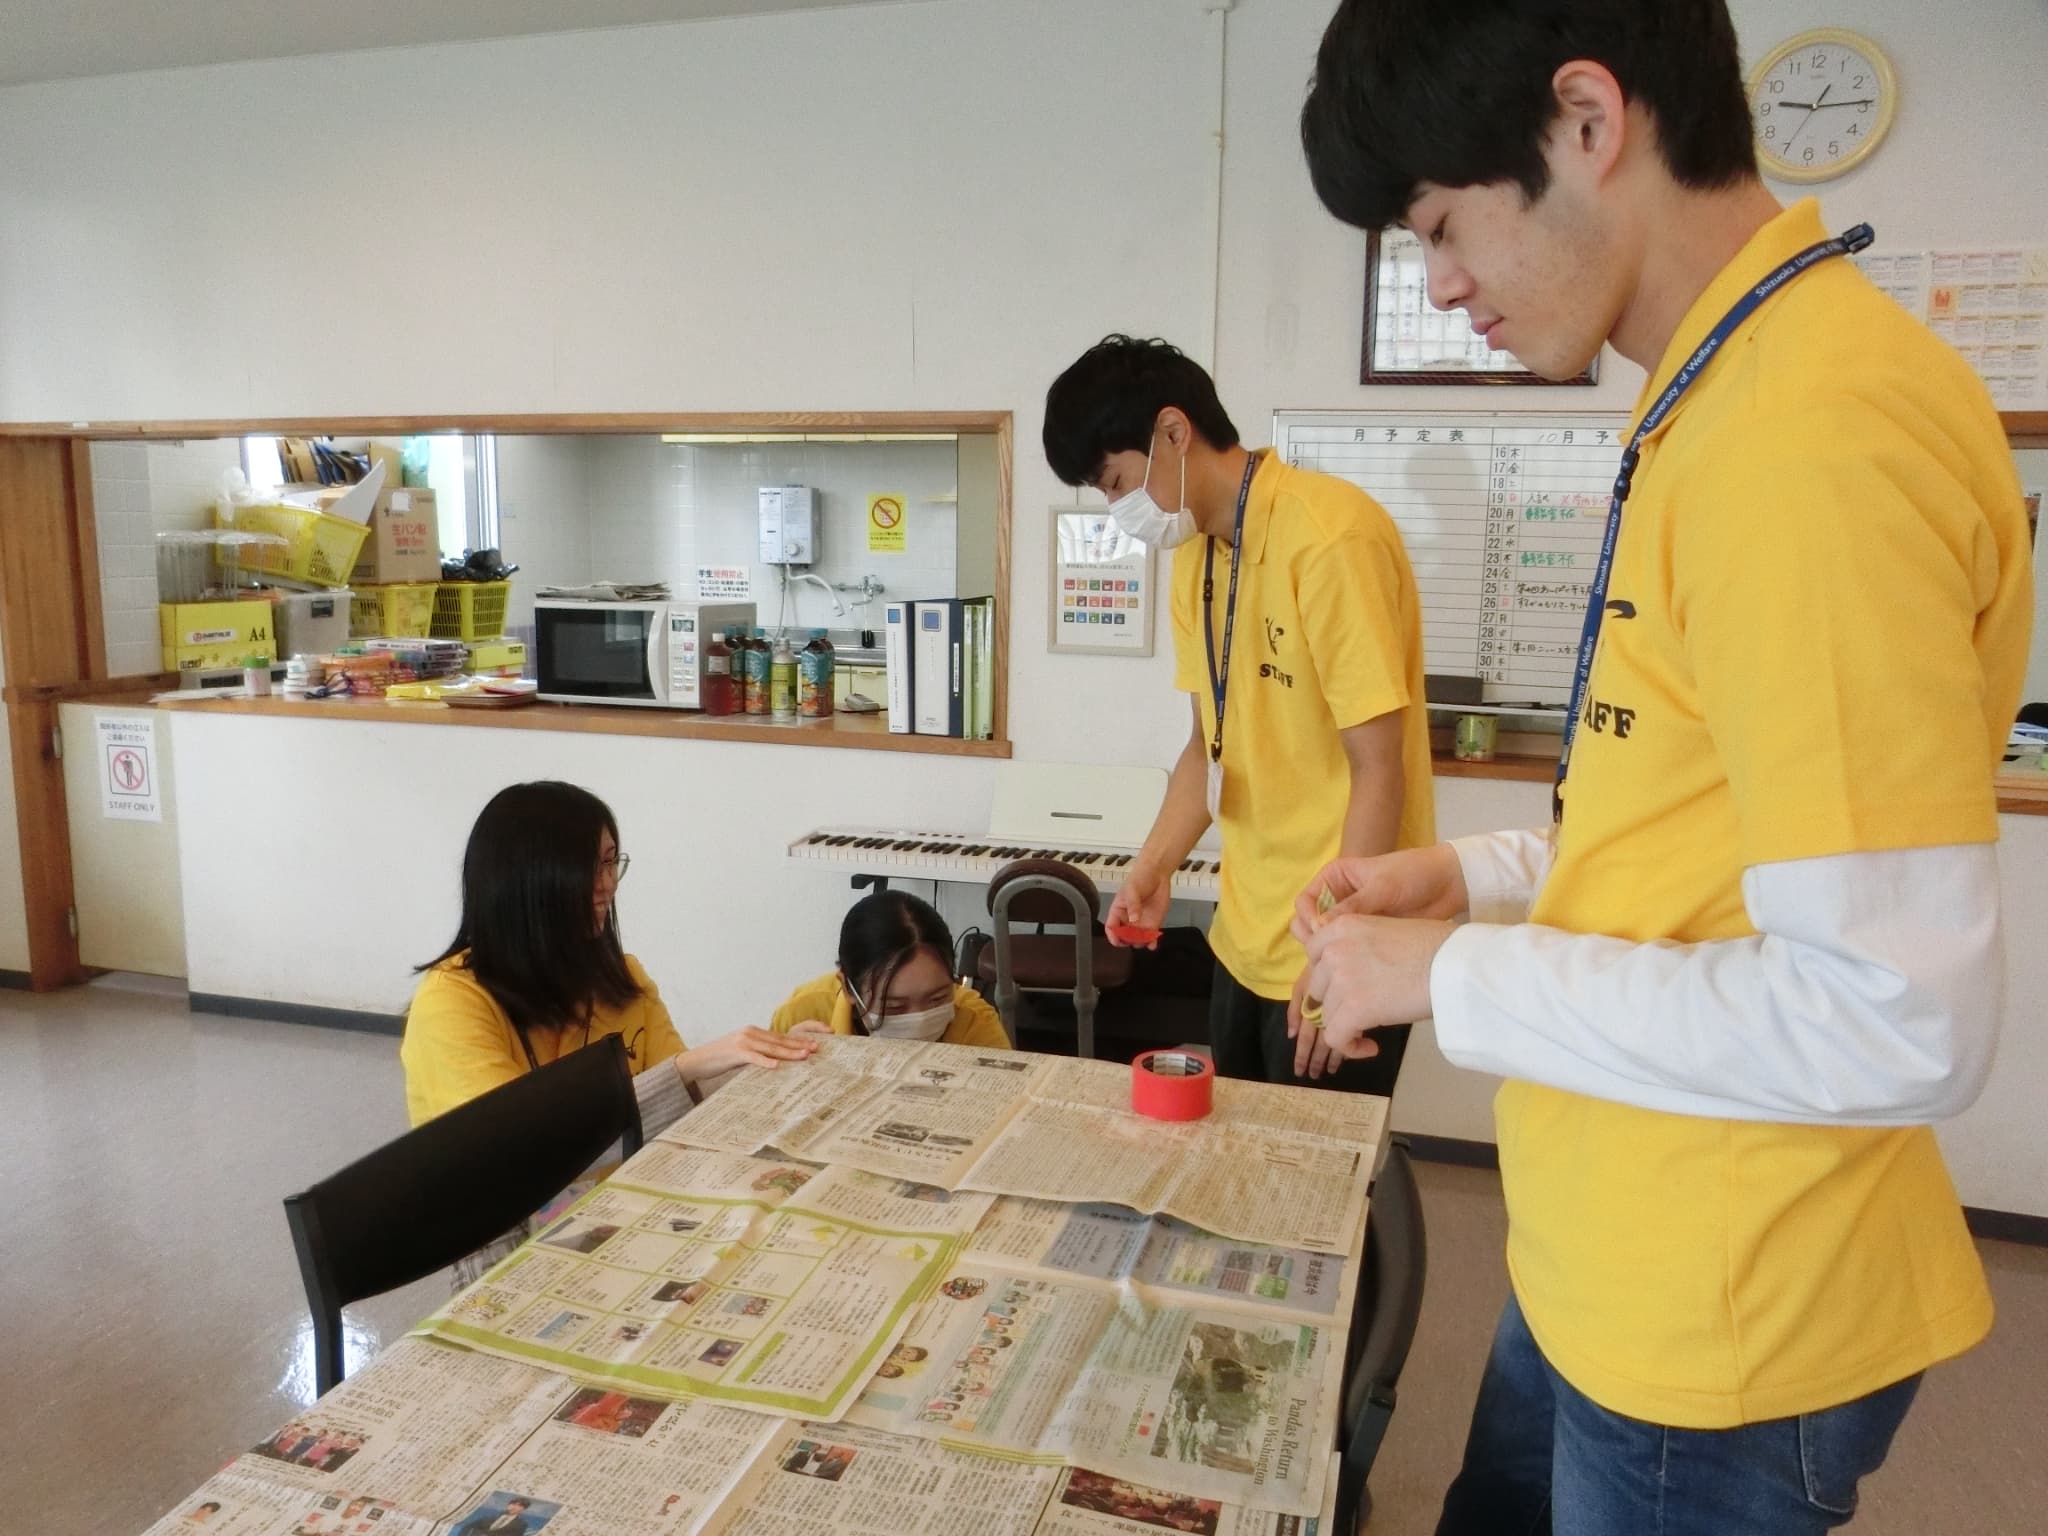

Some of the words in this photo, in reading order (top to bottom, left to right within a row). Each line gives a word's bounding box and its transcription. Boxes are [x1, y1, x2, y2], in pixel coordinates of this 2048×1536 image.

[1811, 54, 1826, 68] 12
[1840, 60, 1845, 72] 1
[1788, 61, 1801, 75] 11
[1769, 80, 1784, 94] 10
[1853, 76, 1864, 90] 2
[1760, 102, 1771, 116] 9
[1764, 126, 1776, 139] 8
[1846, 123, 1858, 136] 4
[1782, 142, 1791, 156] 7
[1827, 140, 1839, 154] 5
[1802, 147, 1814, 160] 6
[1755, 265, 1796, 297] Shizuoka
[1644, 386, 1679, 428] University
[1680, 372, 1689, 384] of
[1686, 338, 1718, 372] Welfare
[1495, 447, 1506, 458] 16
[1510, 448, 1520, 458] 木
[1292, 459, 1300, 470] 2
[1494, 462, 1506, 473] 17
[1508, 464, 1520, 474] 金
[1493, 478, 1504, 488] 18
[1492, 493, 1504, 504] 19
[1490, 508, 1502, 519] 20
[1506, 509, 1514, 519] 月
[1488, 523, 1500, 534] 21
[1488, 538, 1500, 549] 22
[1486, 553, 1500, 564] 23
[1594, 560, 1608, 595] Shizuoka
[1603, 512, 1618, 555] University
[1486, 568, 1498, 578] 24
[1484, 582, 1497, 594] 25
[1484, 598, 1496, 608] 26
[1482, 612, 1495, 623] 27
[249, 627, 266, 642] A4
[1481, 627, 1494, 638] 28
[1480, 642, 1493, 652] 29
[1582, 636, 1594, 666] Welfare
[1480, 656, 1492, 666] 30
[108, 800, 132, 810] STAFF
[134, 802, 156, 812] ONLY
[1267, 1416, 1279, 1426] to
[1284, 1398, 1307, 1436] Pandas
[1254, 1429, 1279, 1486] Washington
[1276, 1440, 1299, 1480] Return
